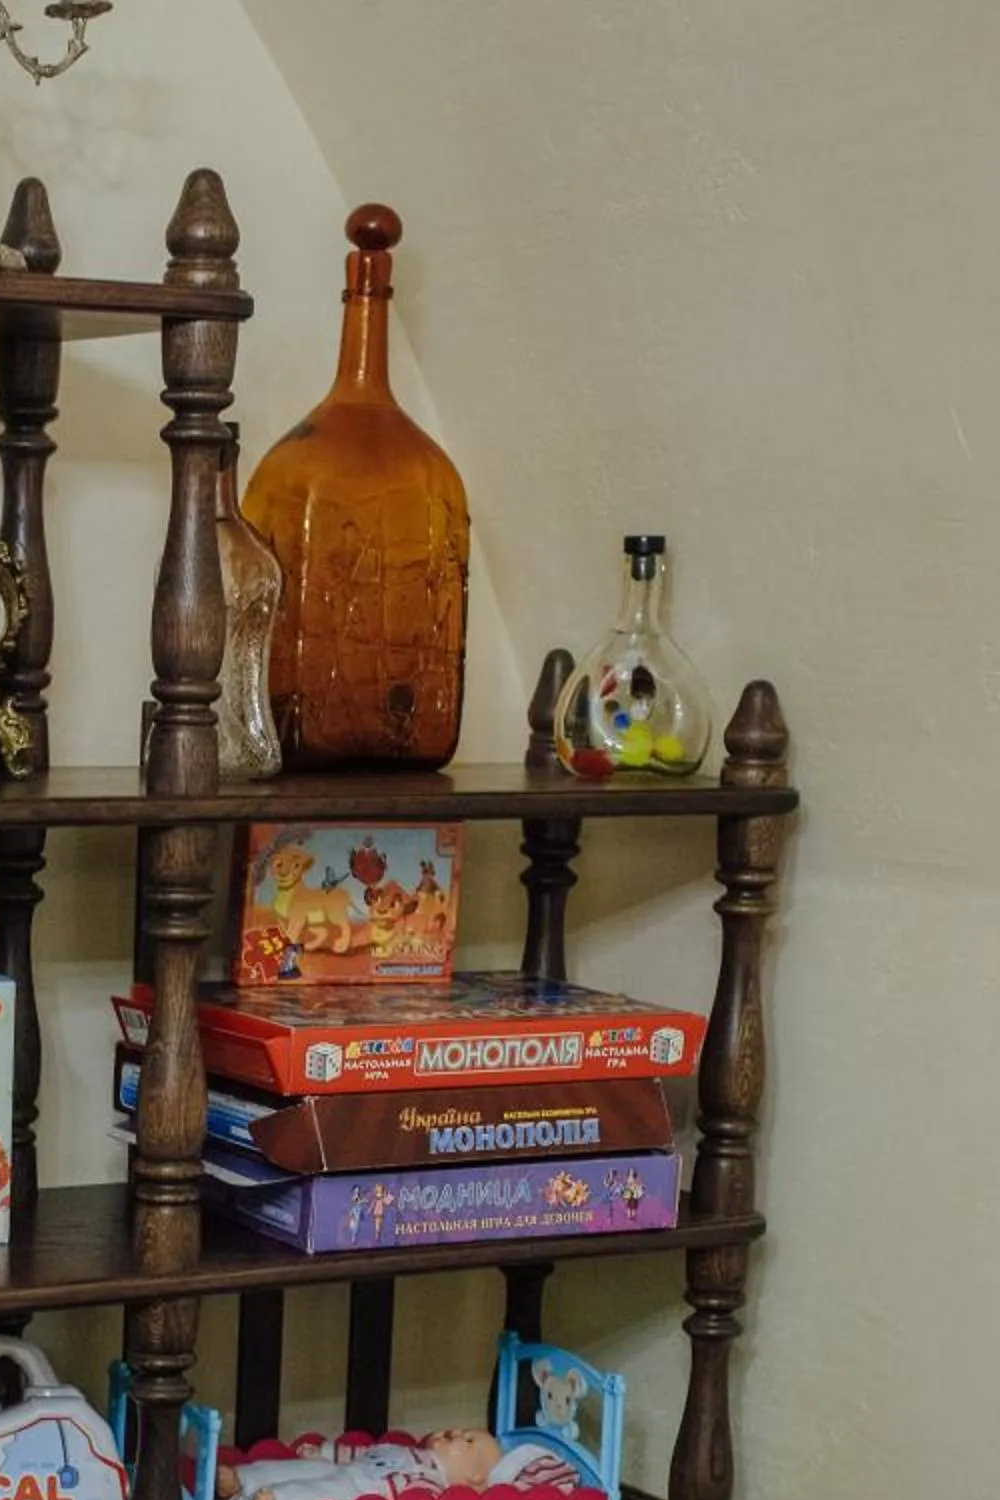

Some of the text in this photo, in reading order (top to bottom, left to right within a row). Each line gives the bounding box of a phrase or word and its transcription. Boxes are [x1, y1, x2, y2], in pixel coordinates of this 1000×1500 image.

[344, 1059, 412, 1070] НАСТОЛЬНАЯ
[419, 1035, 579, 1070] МОНОПОЛІЯ
[399, 1106, 481, 1131] Україна
[428, 1118, 600, 1154] МОНОПОЛІЯ
[395, 1221, 477, 1235] НАСТОЛЬНАЯ
[481, 1217, 510, 1230] ИГРА
